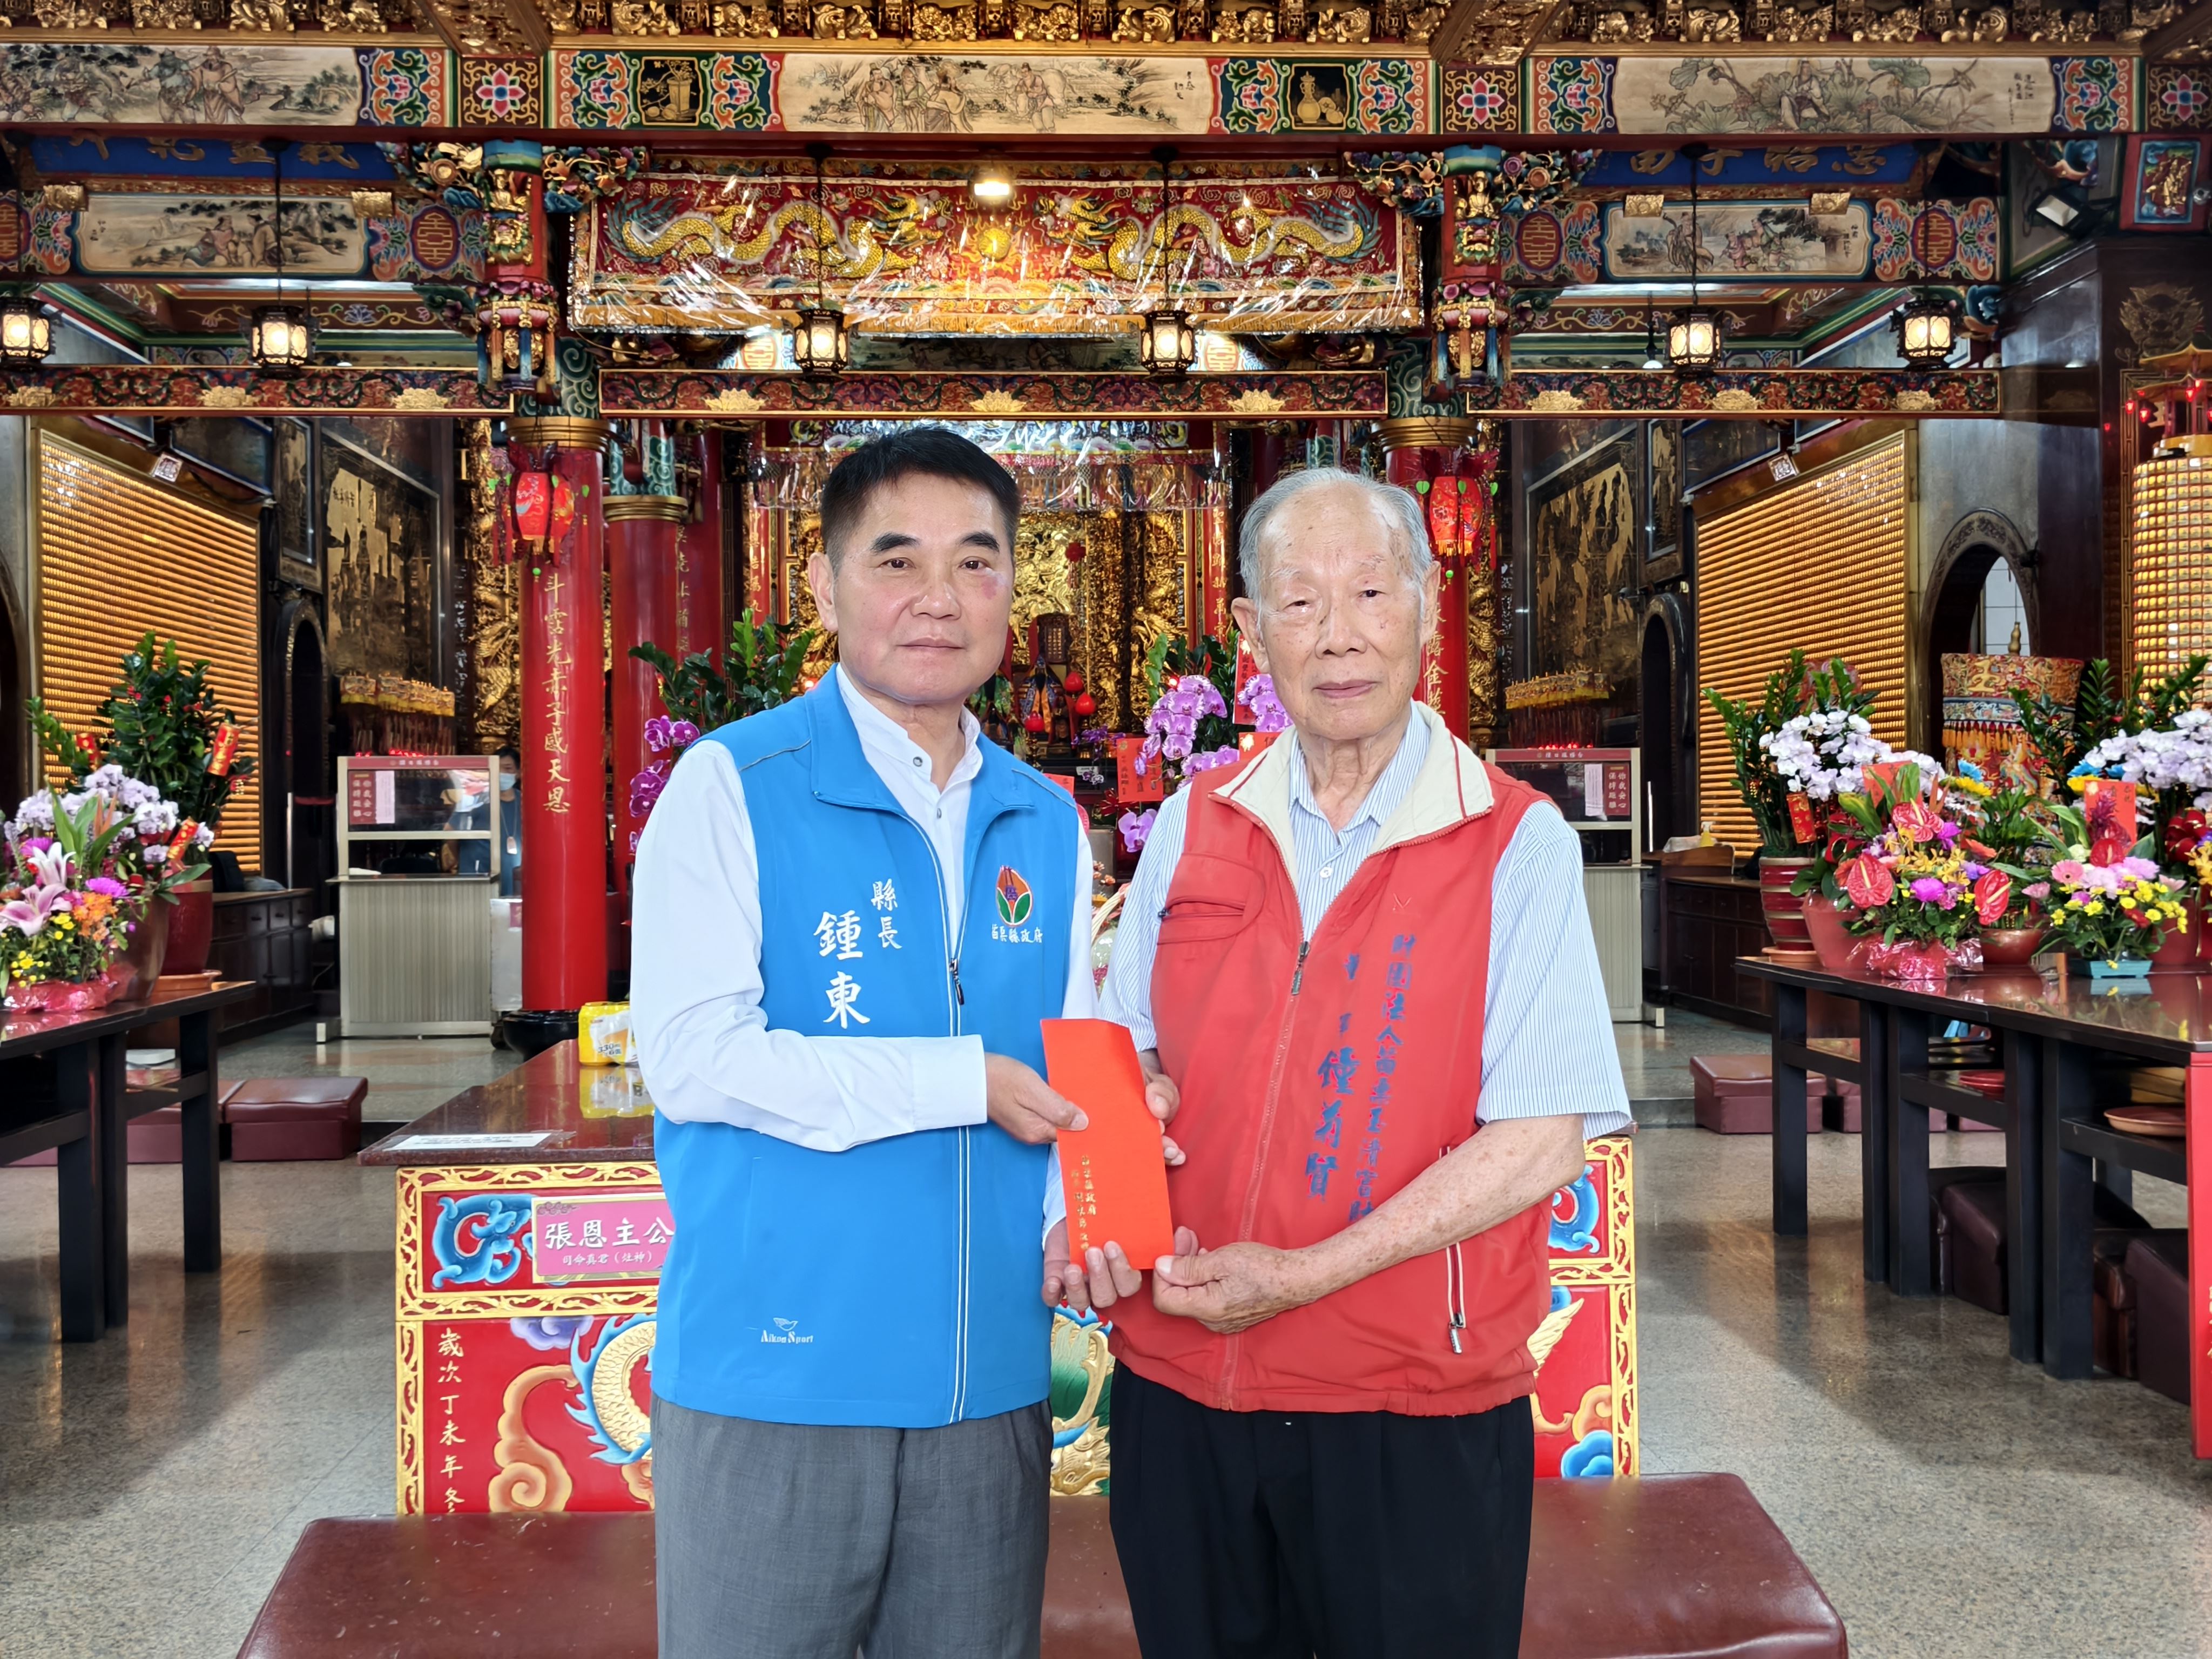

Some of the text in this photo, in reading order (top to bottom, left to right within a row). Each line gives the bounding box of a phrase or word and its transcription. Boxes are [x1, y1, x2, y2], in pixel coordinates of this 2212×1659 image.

[871, 878, 903, 949] 縣長
[813, 909, 871, 1030] 鍾東
[545, 1217, 675, 1250] 張恩主公
[438, 1327, 466, 1513] 歲次丁未年冬
